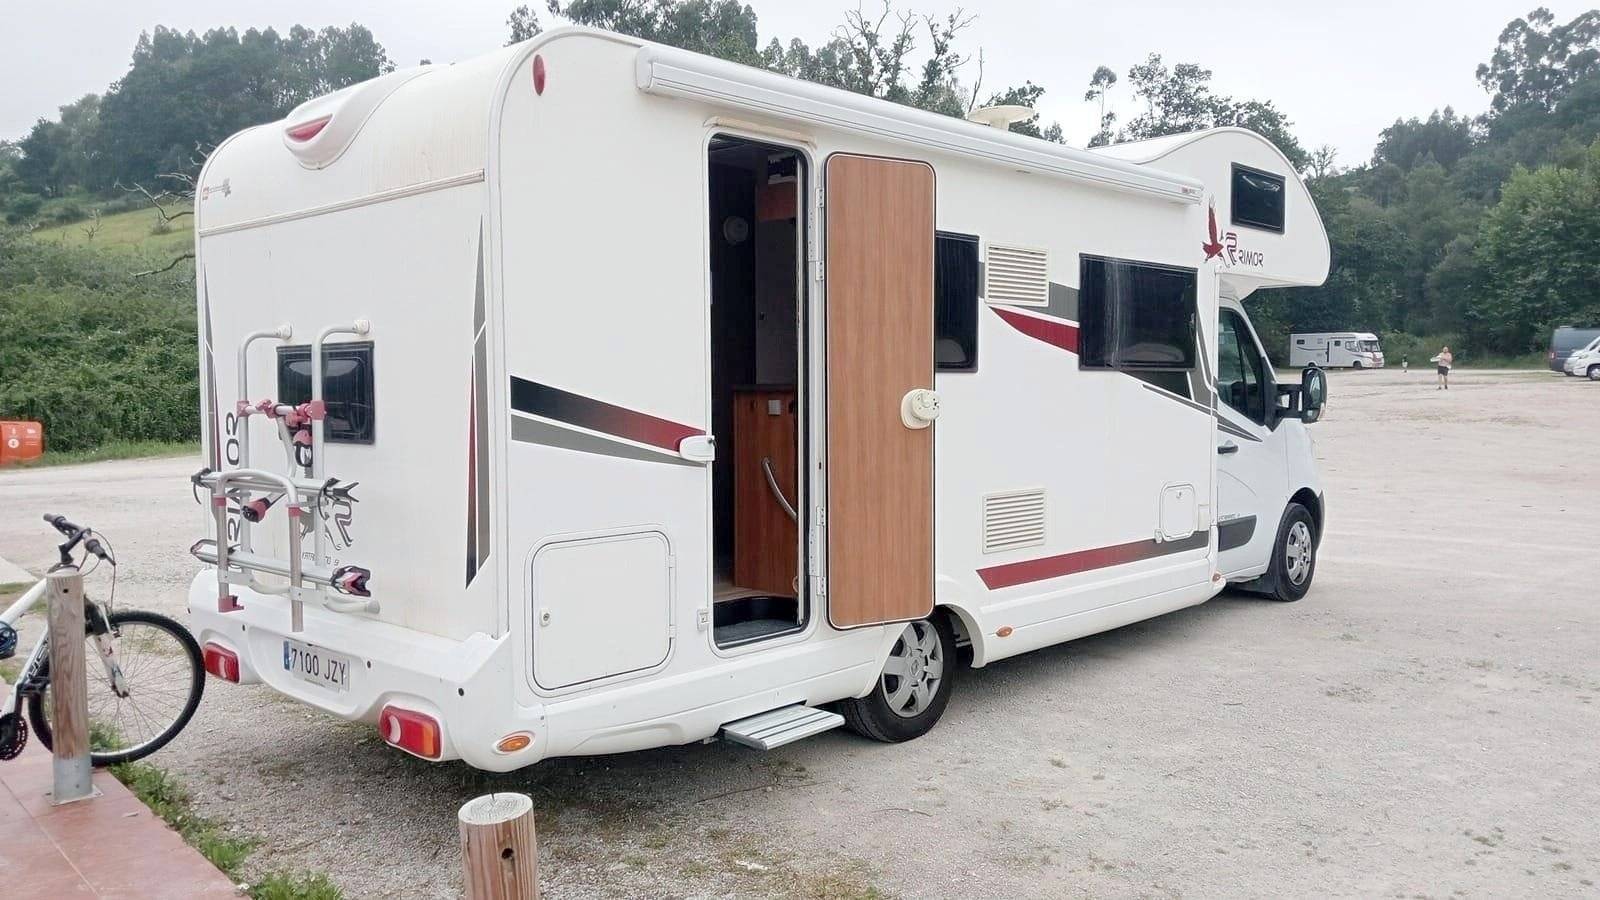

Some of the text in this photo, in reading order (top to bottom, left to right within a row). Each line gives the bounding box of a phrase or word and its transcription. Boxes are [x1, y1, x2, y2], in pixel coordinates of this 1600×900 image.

[1239, 249, 1264, 268] RIMOR
[292, 647, 346, 685] 7100 JZY
